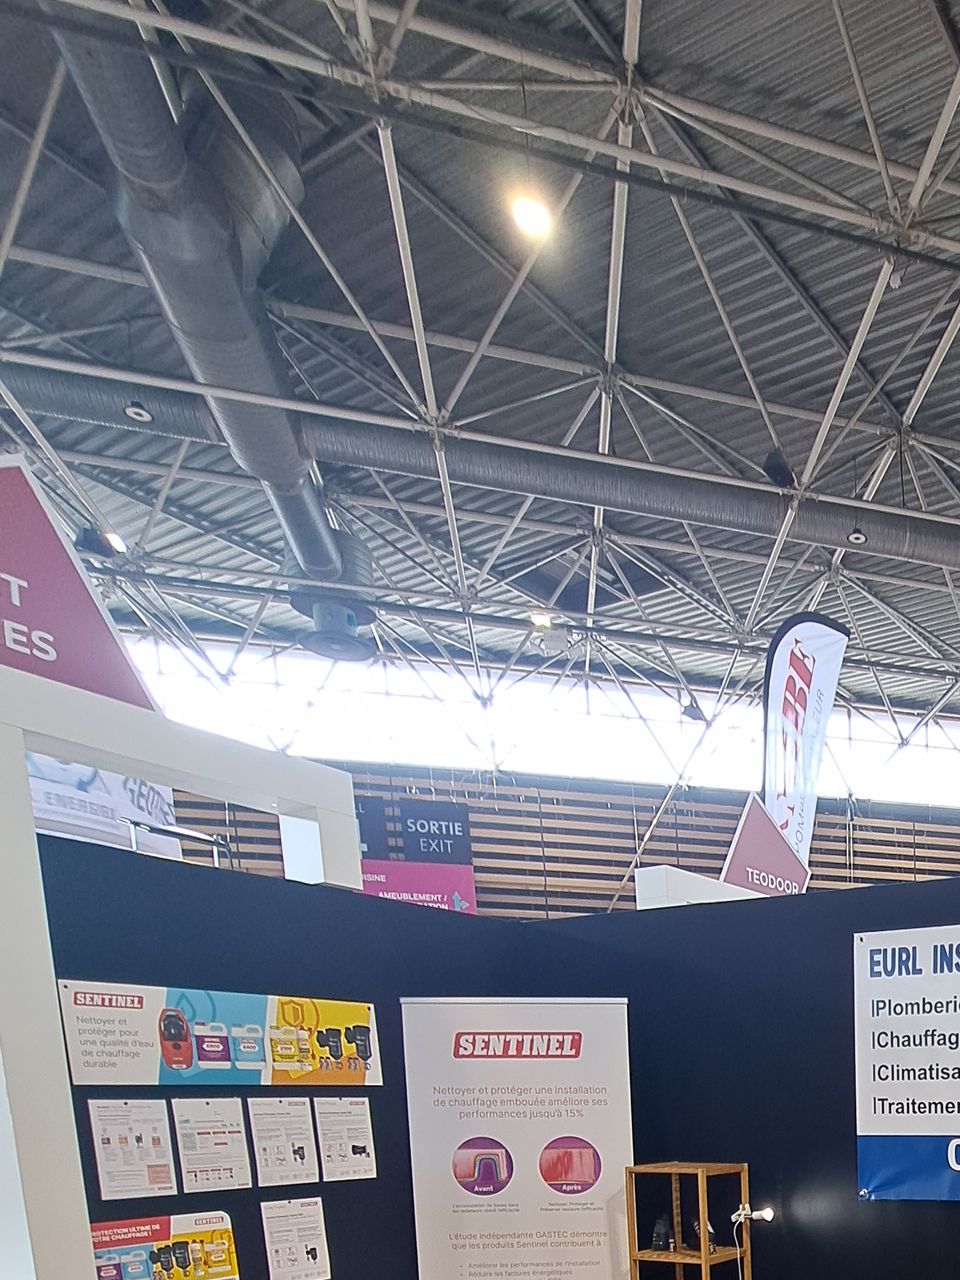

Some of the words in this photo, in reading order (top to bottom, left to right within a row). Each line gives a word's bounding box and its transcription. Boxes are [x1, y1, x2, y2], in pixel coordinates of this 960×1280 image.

[407, 819, 463, 836] SORTIE
[420, 838, 454, 854] EXIT
[746, 867, 799, 894] TEODOOR
[869, 947, 923, 978] EURL
[76, 992, 141, 1008] SENTINEL
[76, 1016, 115, 1026] Nettoyer
[118, 1018, 127, 1026] et
[78, 1026, 116, 1037] protéger
[119, 1029, 140, 1038] pour
[80, 1038, 97, 1047] une
[100, 1038, 128, 1049] qualité
[131, 1039, 154, 1048] d'eau
[458, 1034, 576, 1056] SENTINEL
[81, 1049, 94, 1058] de
[96, 1048, 141, 1059] chauffage
[83, 1060, 117, 1068] durable
[433, 1086, 476, 1098] Nettoyer
[478, 1086, 488, 1095] et
[490, 1084, 532, 1097] protéger
[534, 1086, 552, 1095] une
[554, 1085, 607, 1095] installation
[433, 1097, 446, 1107] de
[449, 1097, 498, 1109] chauffage
[500, 1096, 546, 1107] embouée
[547, 1096, 588, 1106] améliore
[591, 1098, 608, 1106] ses
[459, 1108, 527, 1120] performances
[529, 1108, 563, 1120] jusqu'à
[564, 1109, 584, 1118] 15%
[562, 1184, 582, 1192] Après
[449, 1232, 477, 1241] L'étude
[479, 1231, 533, 1242] indépendante
[535, 1231, 568, 1239] GASTEC
[570, 1230, 608, 1239] démontre
[451, 1242, 467, 1251] que
[468, 1241, 481, 1249] les
[482, 1240, 515, 1250] produits
[516, 1240, 549, 1249] Sentinel
[550, 1240, 595, 1248] contribuent
